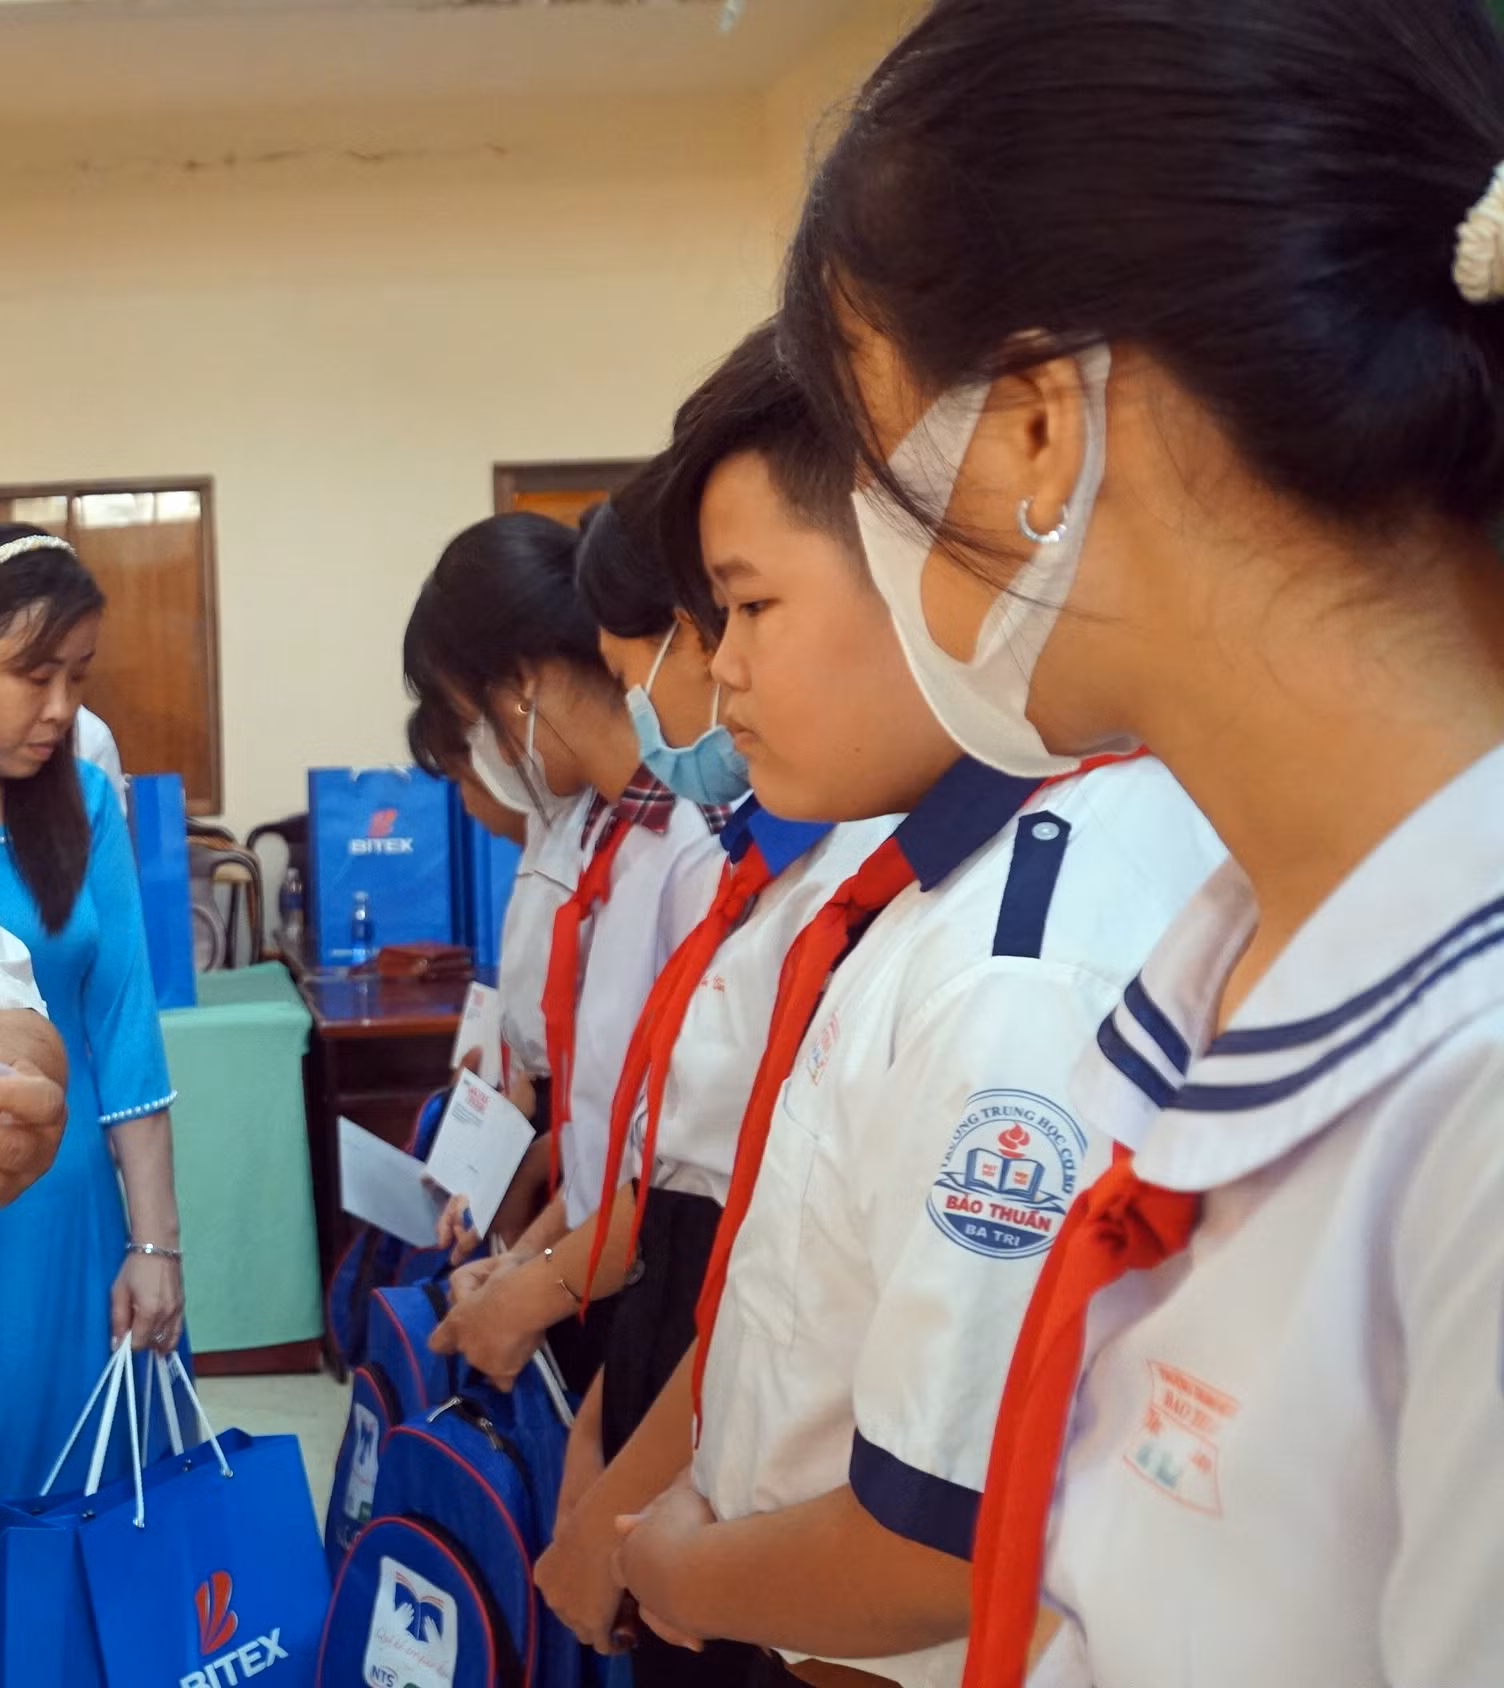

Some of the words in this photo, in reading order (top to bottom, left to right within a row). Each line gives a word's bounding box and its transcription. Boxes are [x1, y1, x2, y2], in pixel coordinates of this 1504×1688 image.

[350, 838, 414, 855] BITEX
[980, 1106, 1037, 1122] TRUNG
[1037, 1117, 1067, 1146] HỌC
[964, 1223, 988, 1239] BA
[993, 1230, 1022, 1247] TRI
[180, 1627, 289, 1688] BITEX
[372, 1665, 395, 1688] NTS
